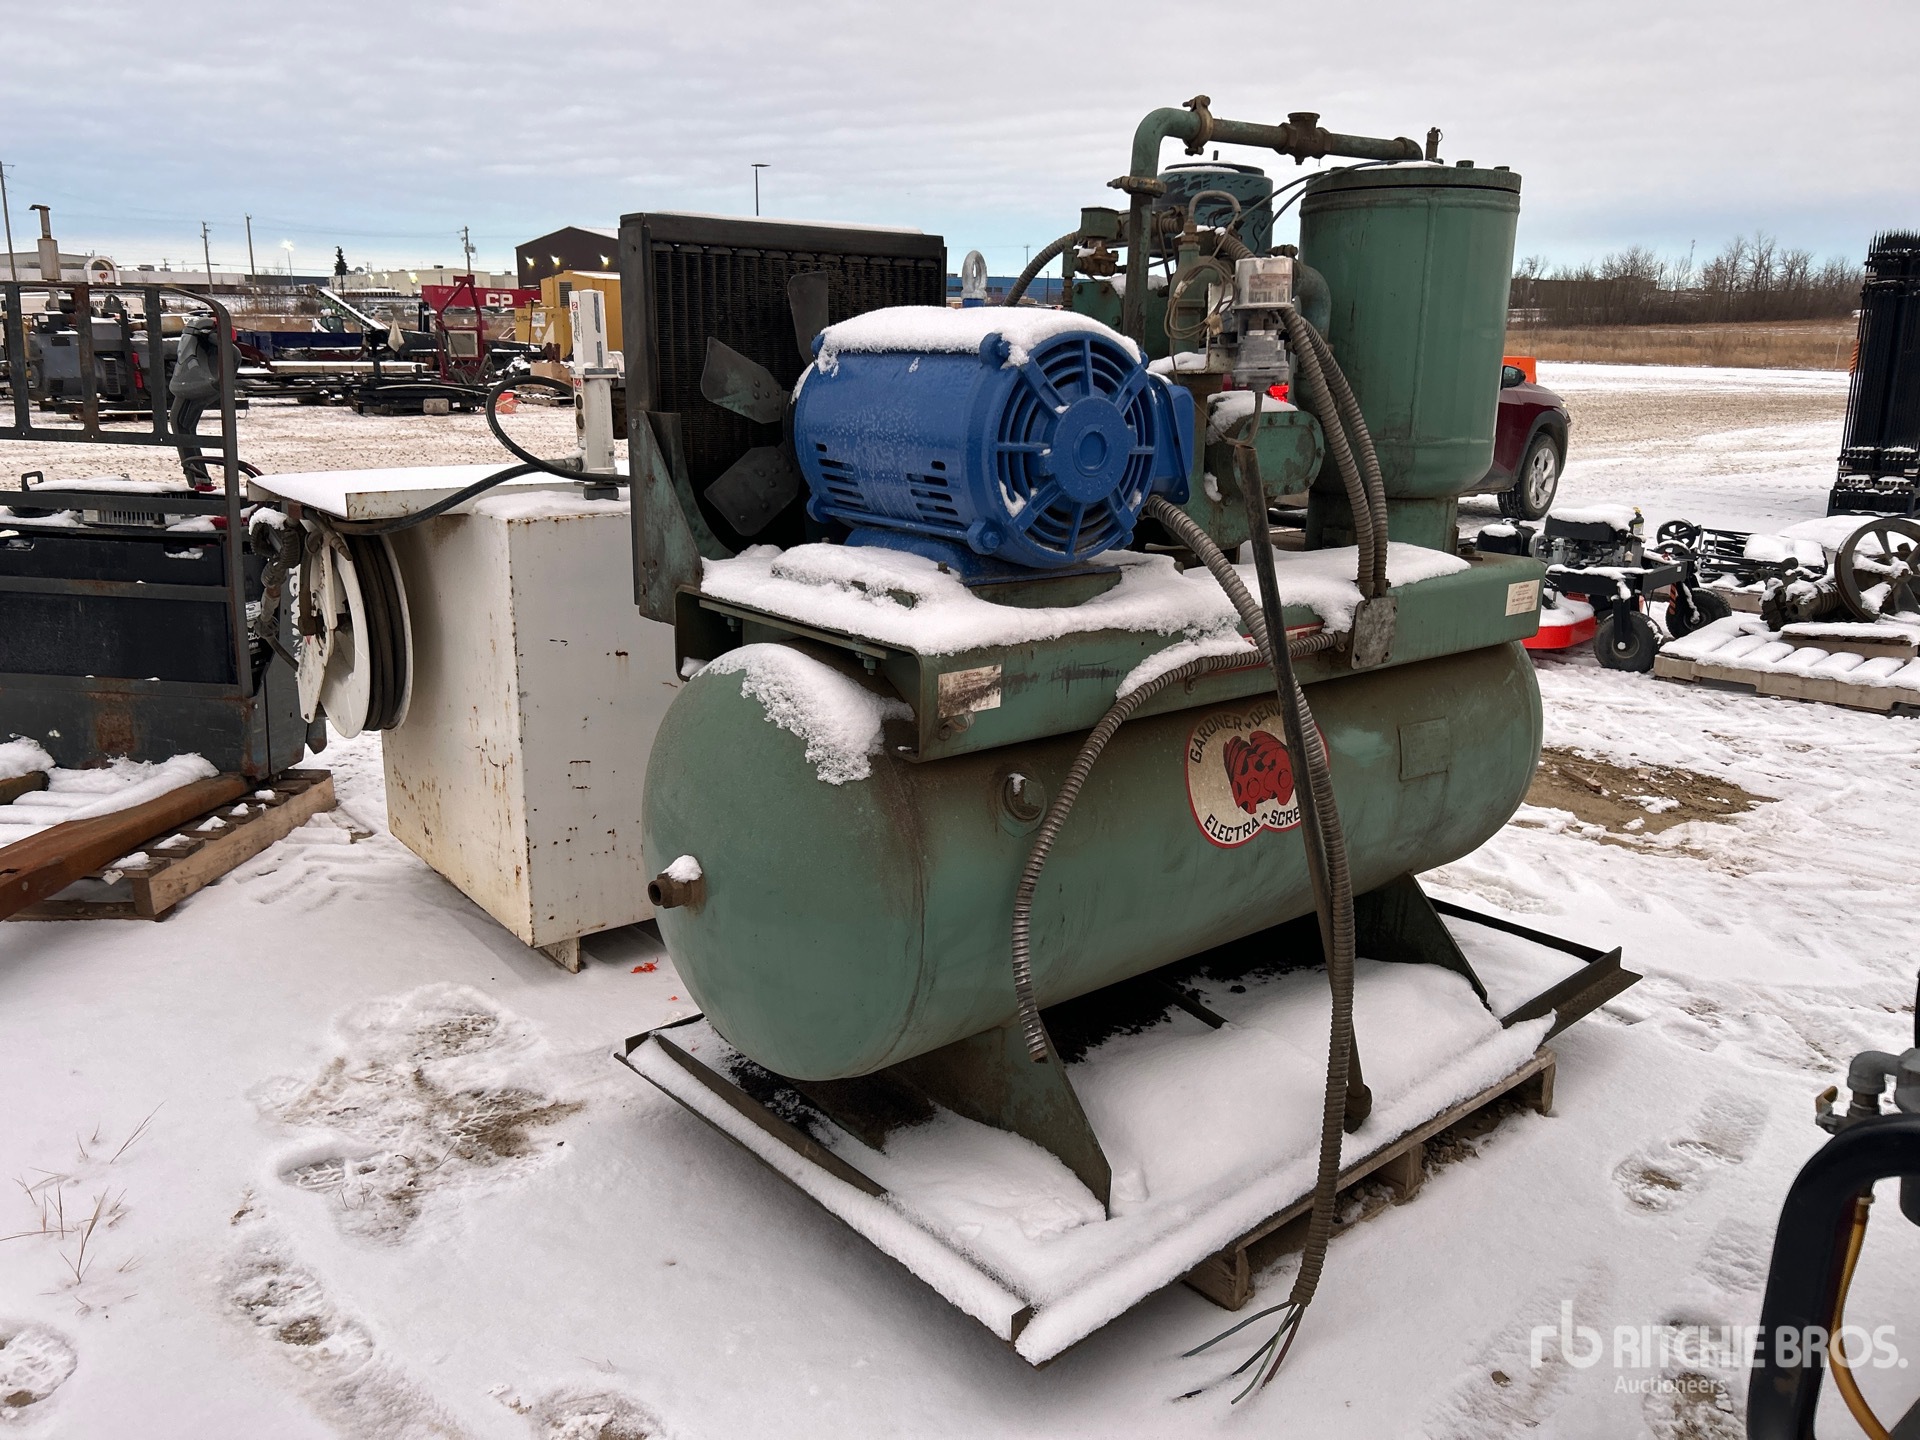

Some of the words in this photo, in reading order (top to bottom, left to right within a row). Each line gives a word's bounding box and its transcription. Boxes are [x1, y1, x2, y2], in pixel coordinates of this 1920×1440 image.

[485, 293, 513, 307] CP
[1190, 714, 1243, 764] GARDNER
[1251, 701, 1282, 727] DENV
[1203, 814, 1260, 842] ELECTRA
[1269, 806, 1300, 826] SCRE
